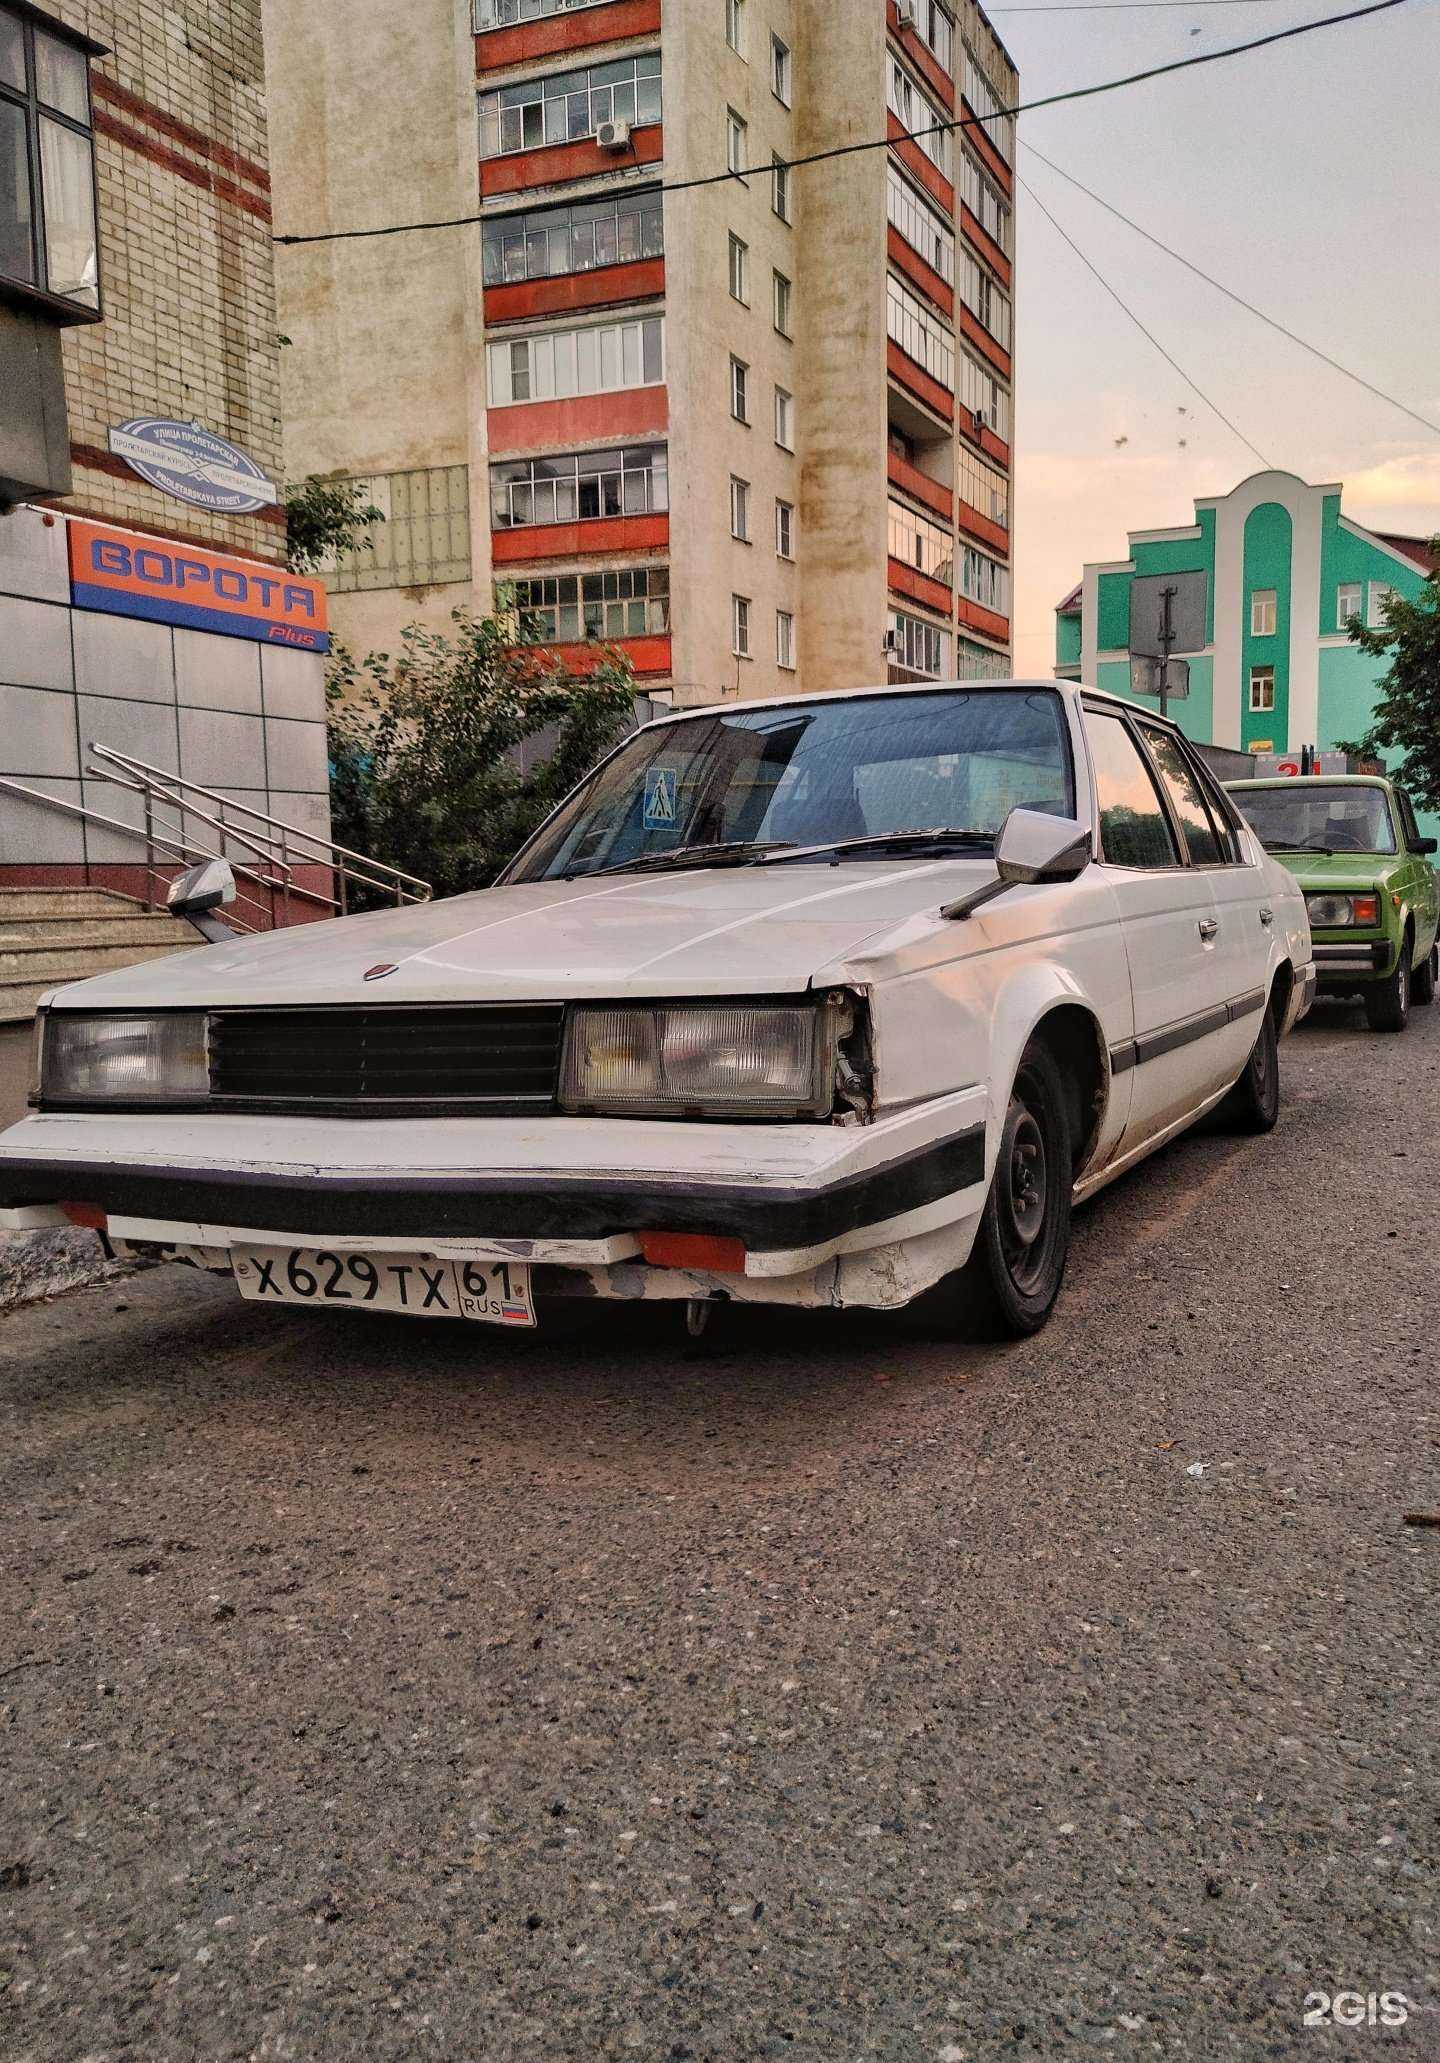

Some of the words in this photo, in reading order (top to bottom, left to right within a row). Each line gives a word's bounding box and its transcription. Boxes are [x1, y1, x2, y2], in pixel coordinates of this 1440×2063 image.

[153, 429, 180, 440] УЛИЦА
[181, 431, 239, 467] ПРОЛЕТАРСКАЯ
[155, 470, 216, 504] PROLETARSKAYA
[216, 495, 240, 506] STREET
[91, 538, 315, 618] ВОРОТА
[268, 625, 316, 646] Plus
[462, 1261, 512, 1301] 61
[463, 1297, 501, 1316] RUS
